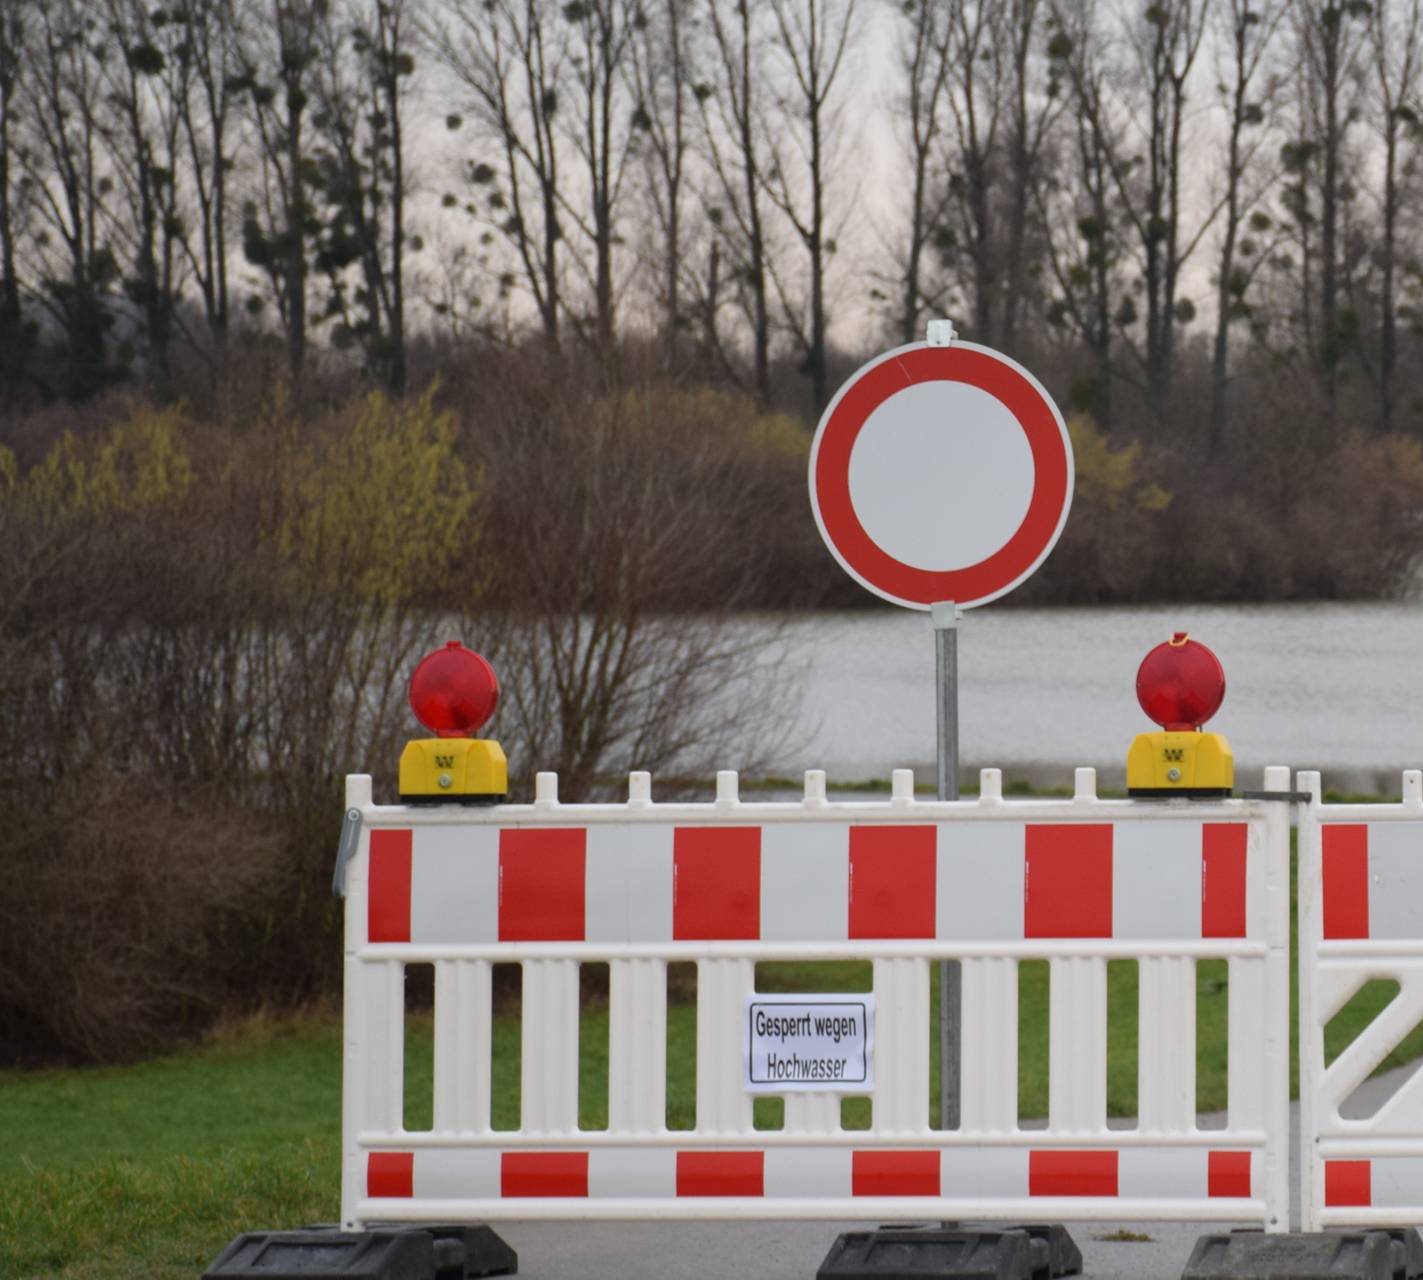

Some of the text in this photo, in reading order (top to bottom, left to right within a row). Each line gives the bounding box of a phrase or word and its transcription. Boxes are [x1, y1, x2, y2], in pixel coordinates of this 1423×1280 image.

[756, 1010, 857, 1044] Gesperrt wegen
[767, 1052, 847, 1079] Hochwasser
